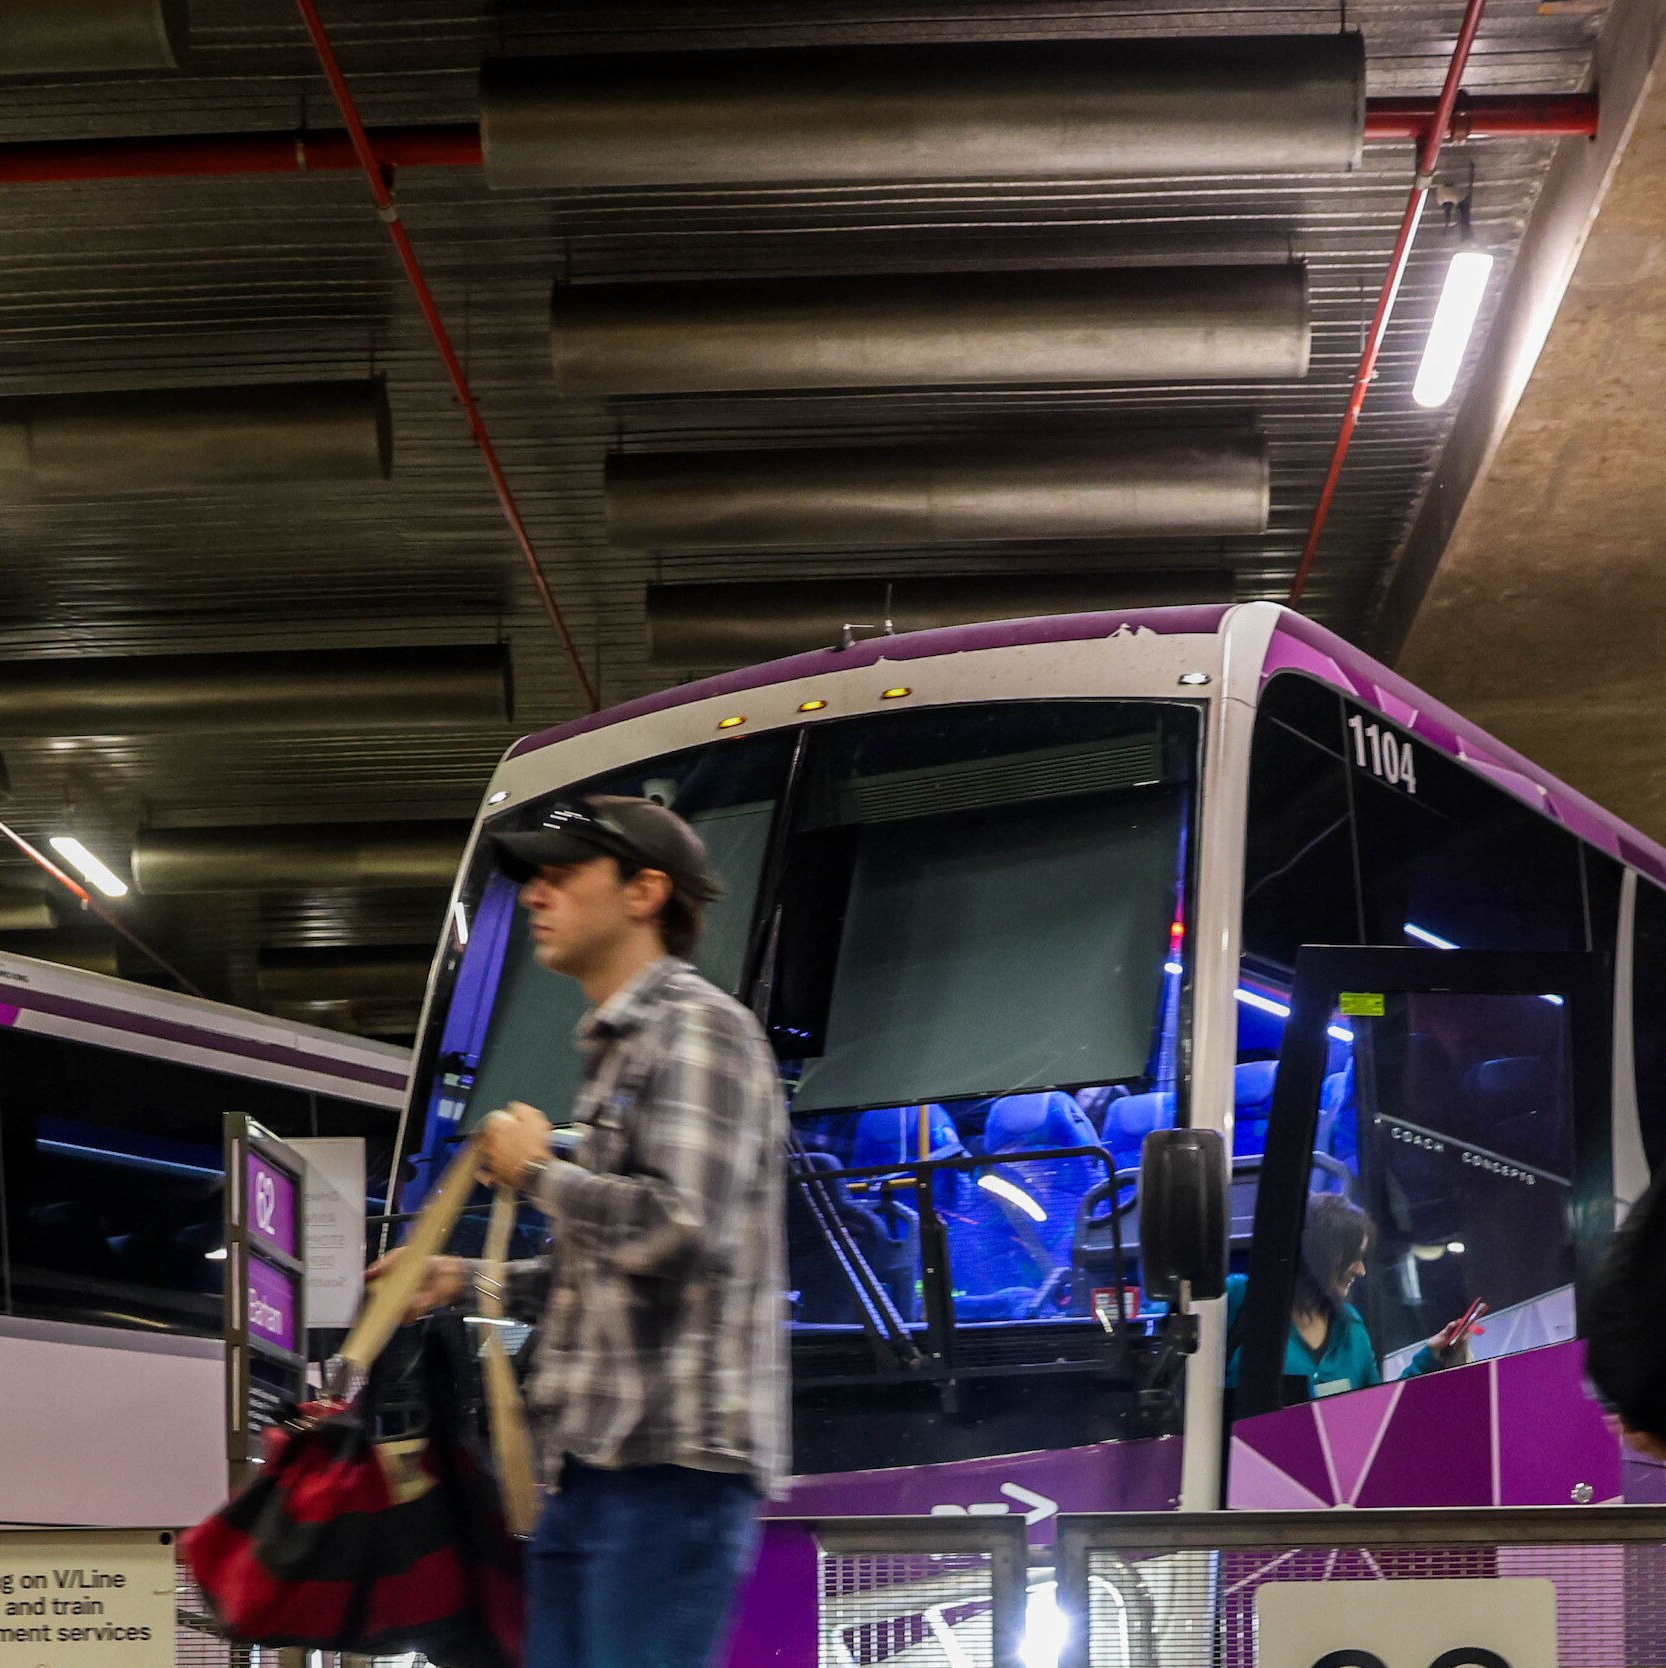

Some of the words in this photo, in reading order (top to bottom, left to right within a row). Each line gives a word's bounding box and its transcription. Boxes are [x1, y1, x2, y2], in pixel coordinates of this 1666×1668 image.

[1347, 714, 1417, 794] 1104
[1390, 1126, 1445, 1152] COACH
[1461, 1151, 1535, 1185] CONCEPTS
[254, 1171, 276, 1235] 62
[19, 1574, 47, 1590] on
[53, 1569, 126, 1589] V/Line
[5, 1597, 46, 1616] and
[52, 1596, 104, 1615] train
[57, 1622, 152, 1642] services
